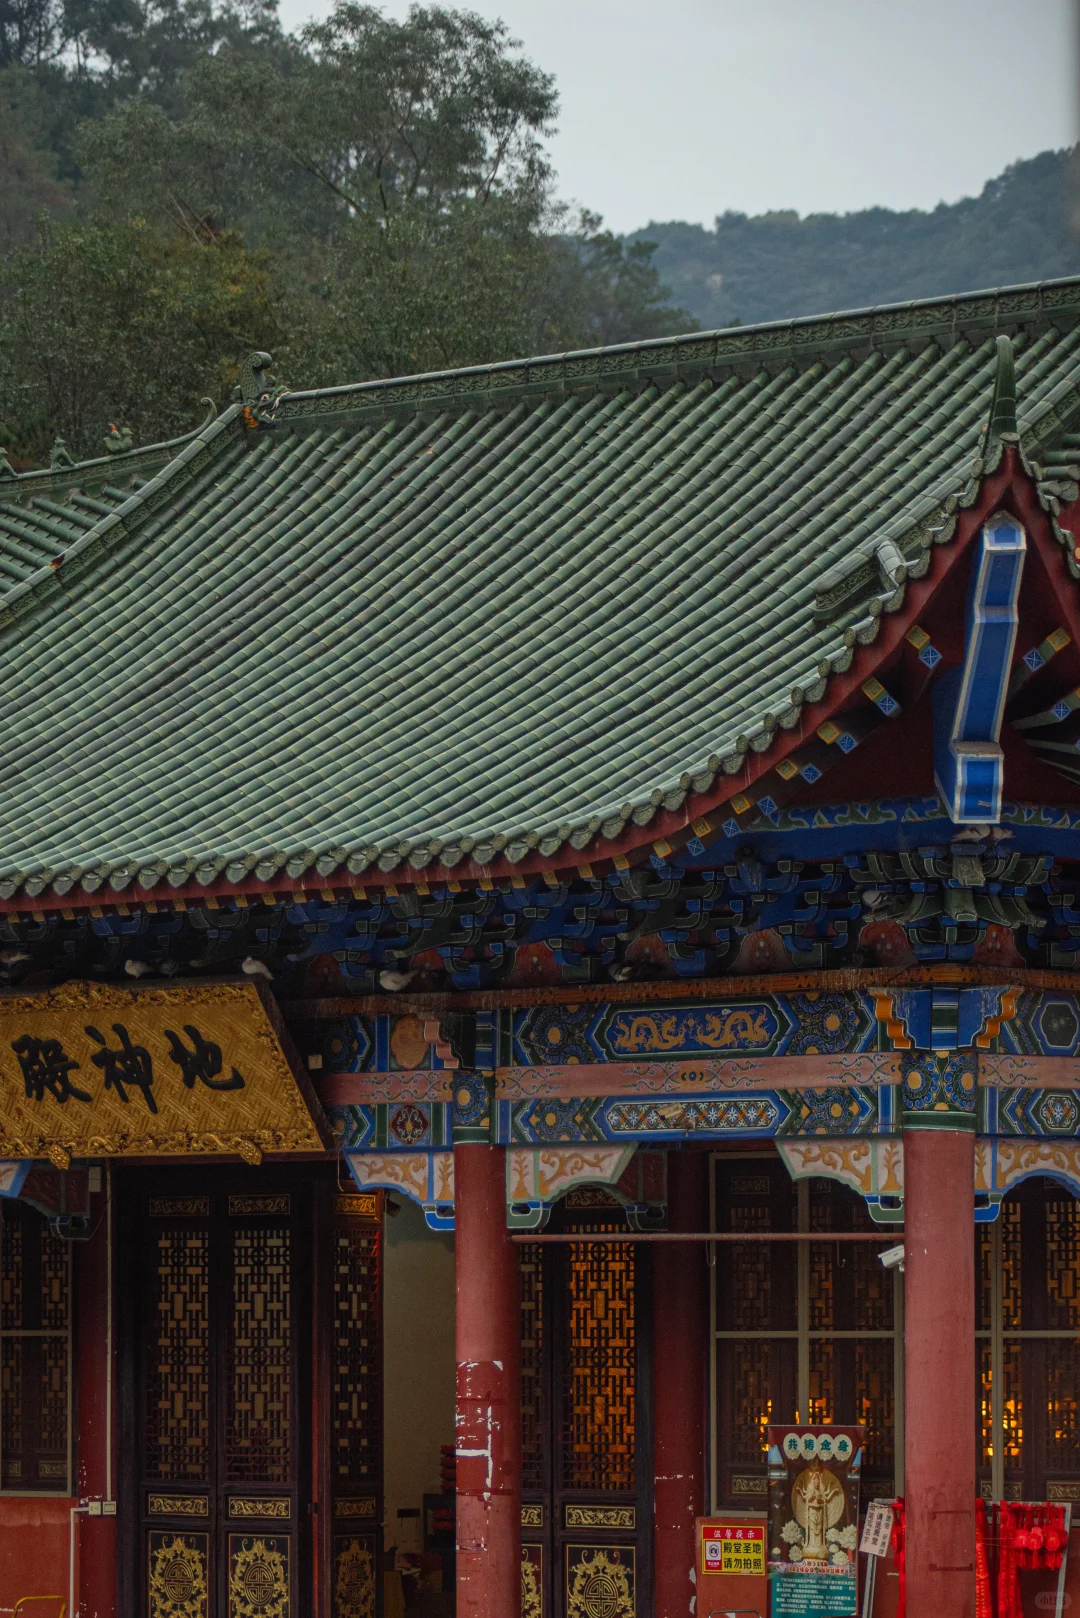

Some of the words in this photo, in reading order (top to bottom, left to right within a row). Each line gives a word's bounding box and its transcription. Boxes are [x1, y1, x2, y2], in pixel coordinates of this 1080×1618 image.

[788, 1438, 849, 1452] 共铸金身
[713, 1528, 755, 1539] 温馨提示
[723, 1542, 762, 1554] 殿堂圣地
[723, 1557, 762, 1570] 请勿拍照
